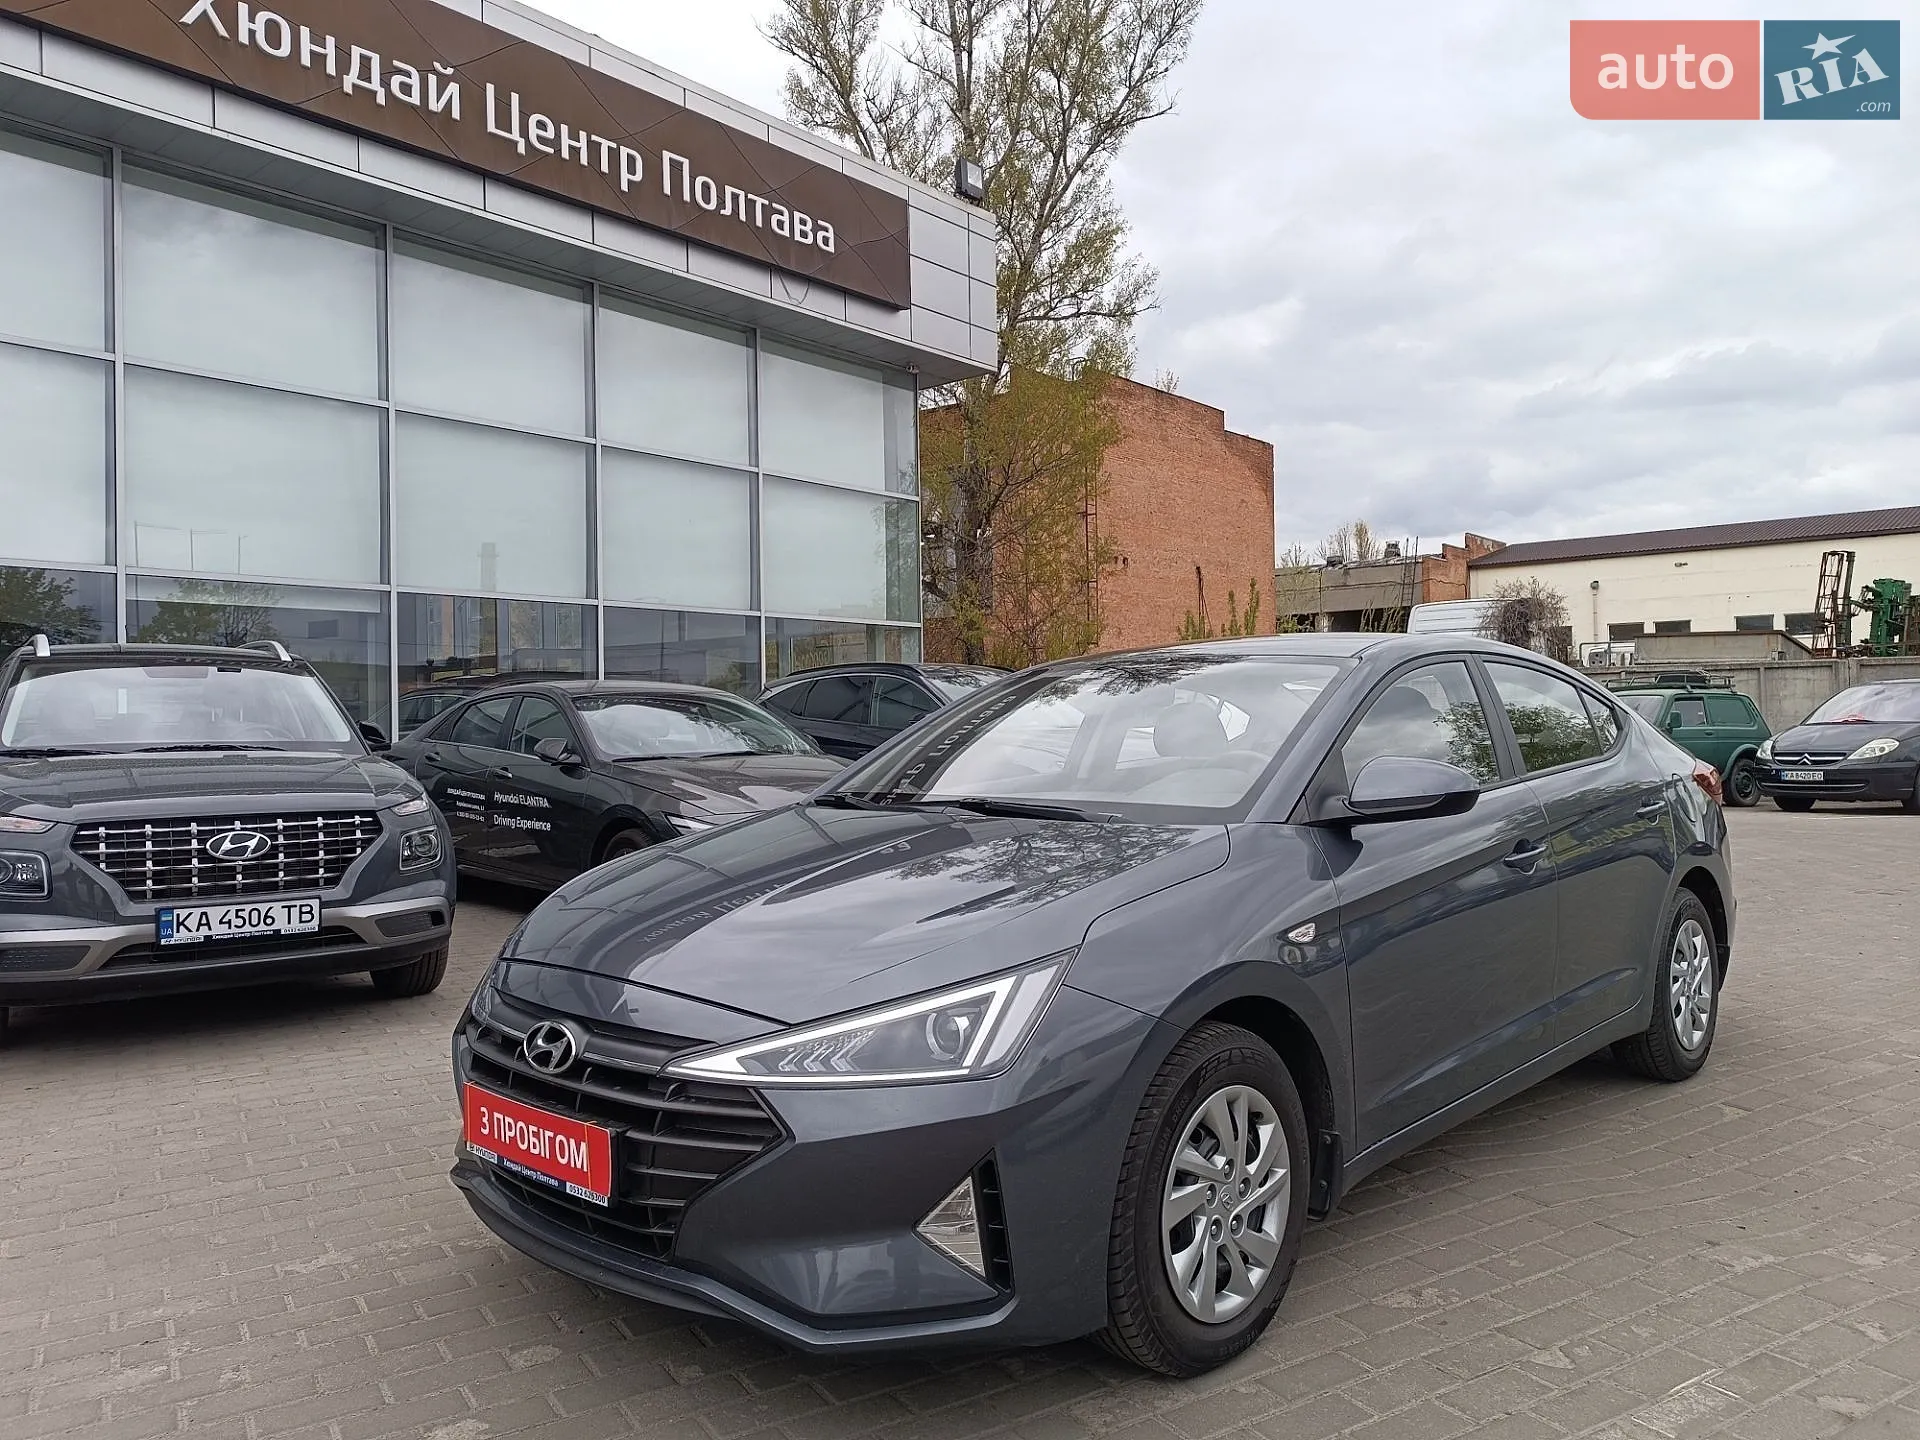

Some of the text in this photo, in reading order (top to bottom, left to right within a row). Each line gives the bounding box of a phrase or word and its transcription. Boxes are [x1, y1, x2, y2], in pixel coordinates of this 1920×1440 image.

[485, 82, 643, 193] Центр
[661, 149, 836, 254] Полтава
[493, 791, 520, 804] Hyundai
[519, 794, 549, 809] ELANTRA
[493, 814, 516, 829] Driving
[516, 816, 552, 832] Experience
[175, 903, 315, 934] KA 4506 TB
[161, 928, 173, 936] UA
[493, 1111, 588, 1173] ПРОБІГОМ
